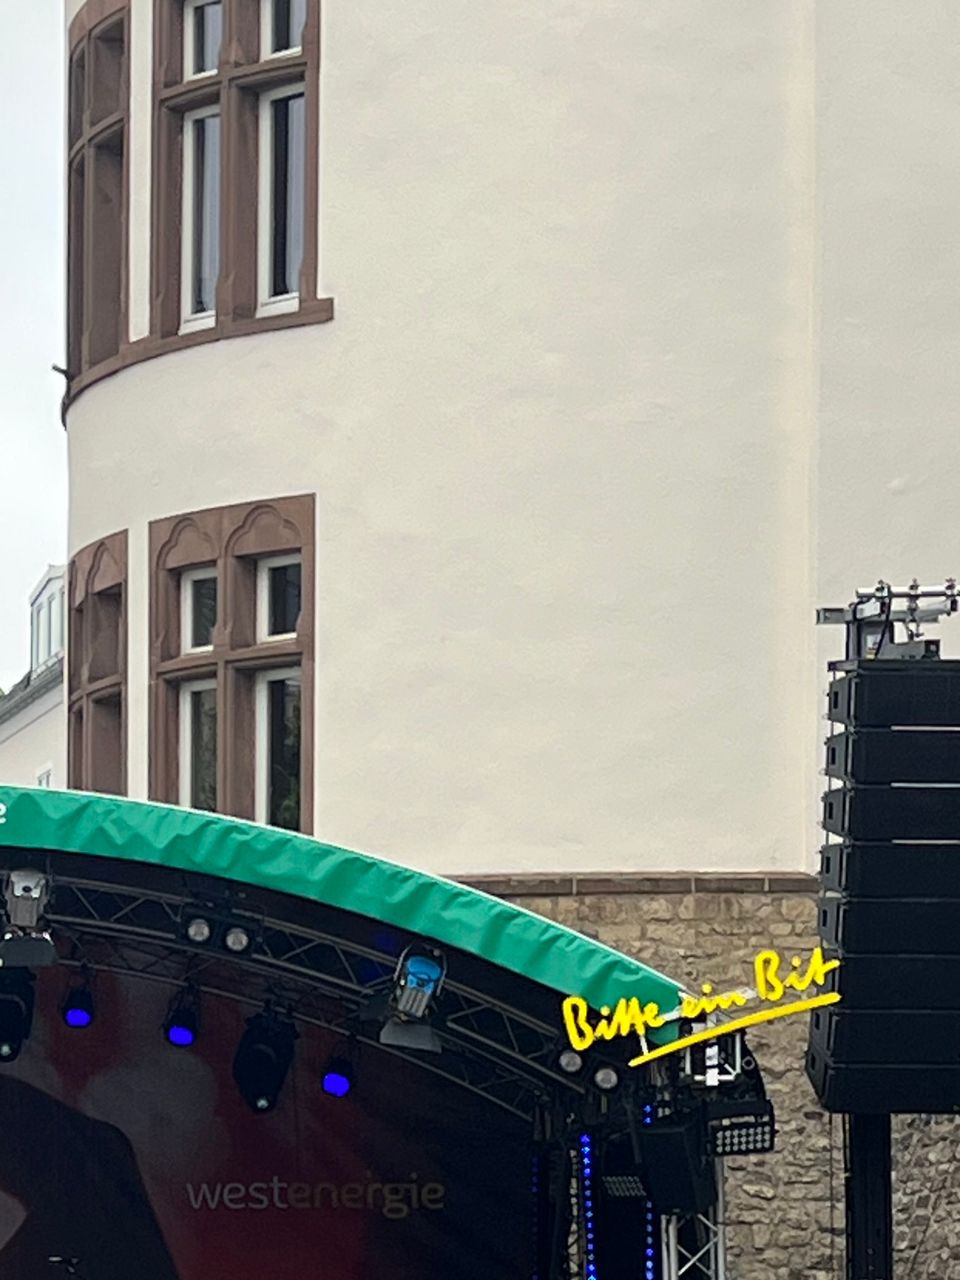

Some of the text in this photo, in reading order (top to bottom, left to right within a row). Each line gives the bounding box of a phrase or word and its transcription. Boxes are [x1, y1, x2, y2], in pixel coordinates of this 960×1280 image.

[562, 946, 841, 1051] Bitte ein Bit
[184, 1170, 446, 1220] westenergie
